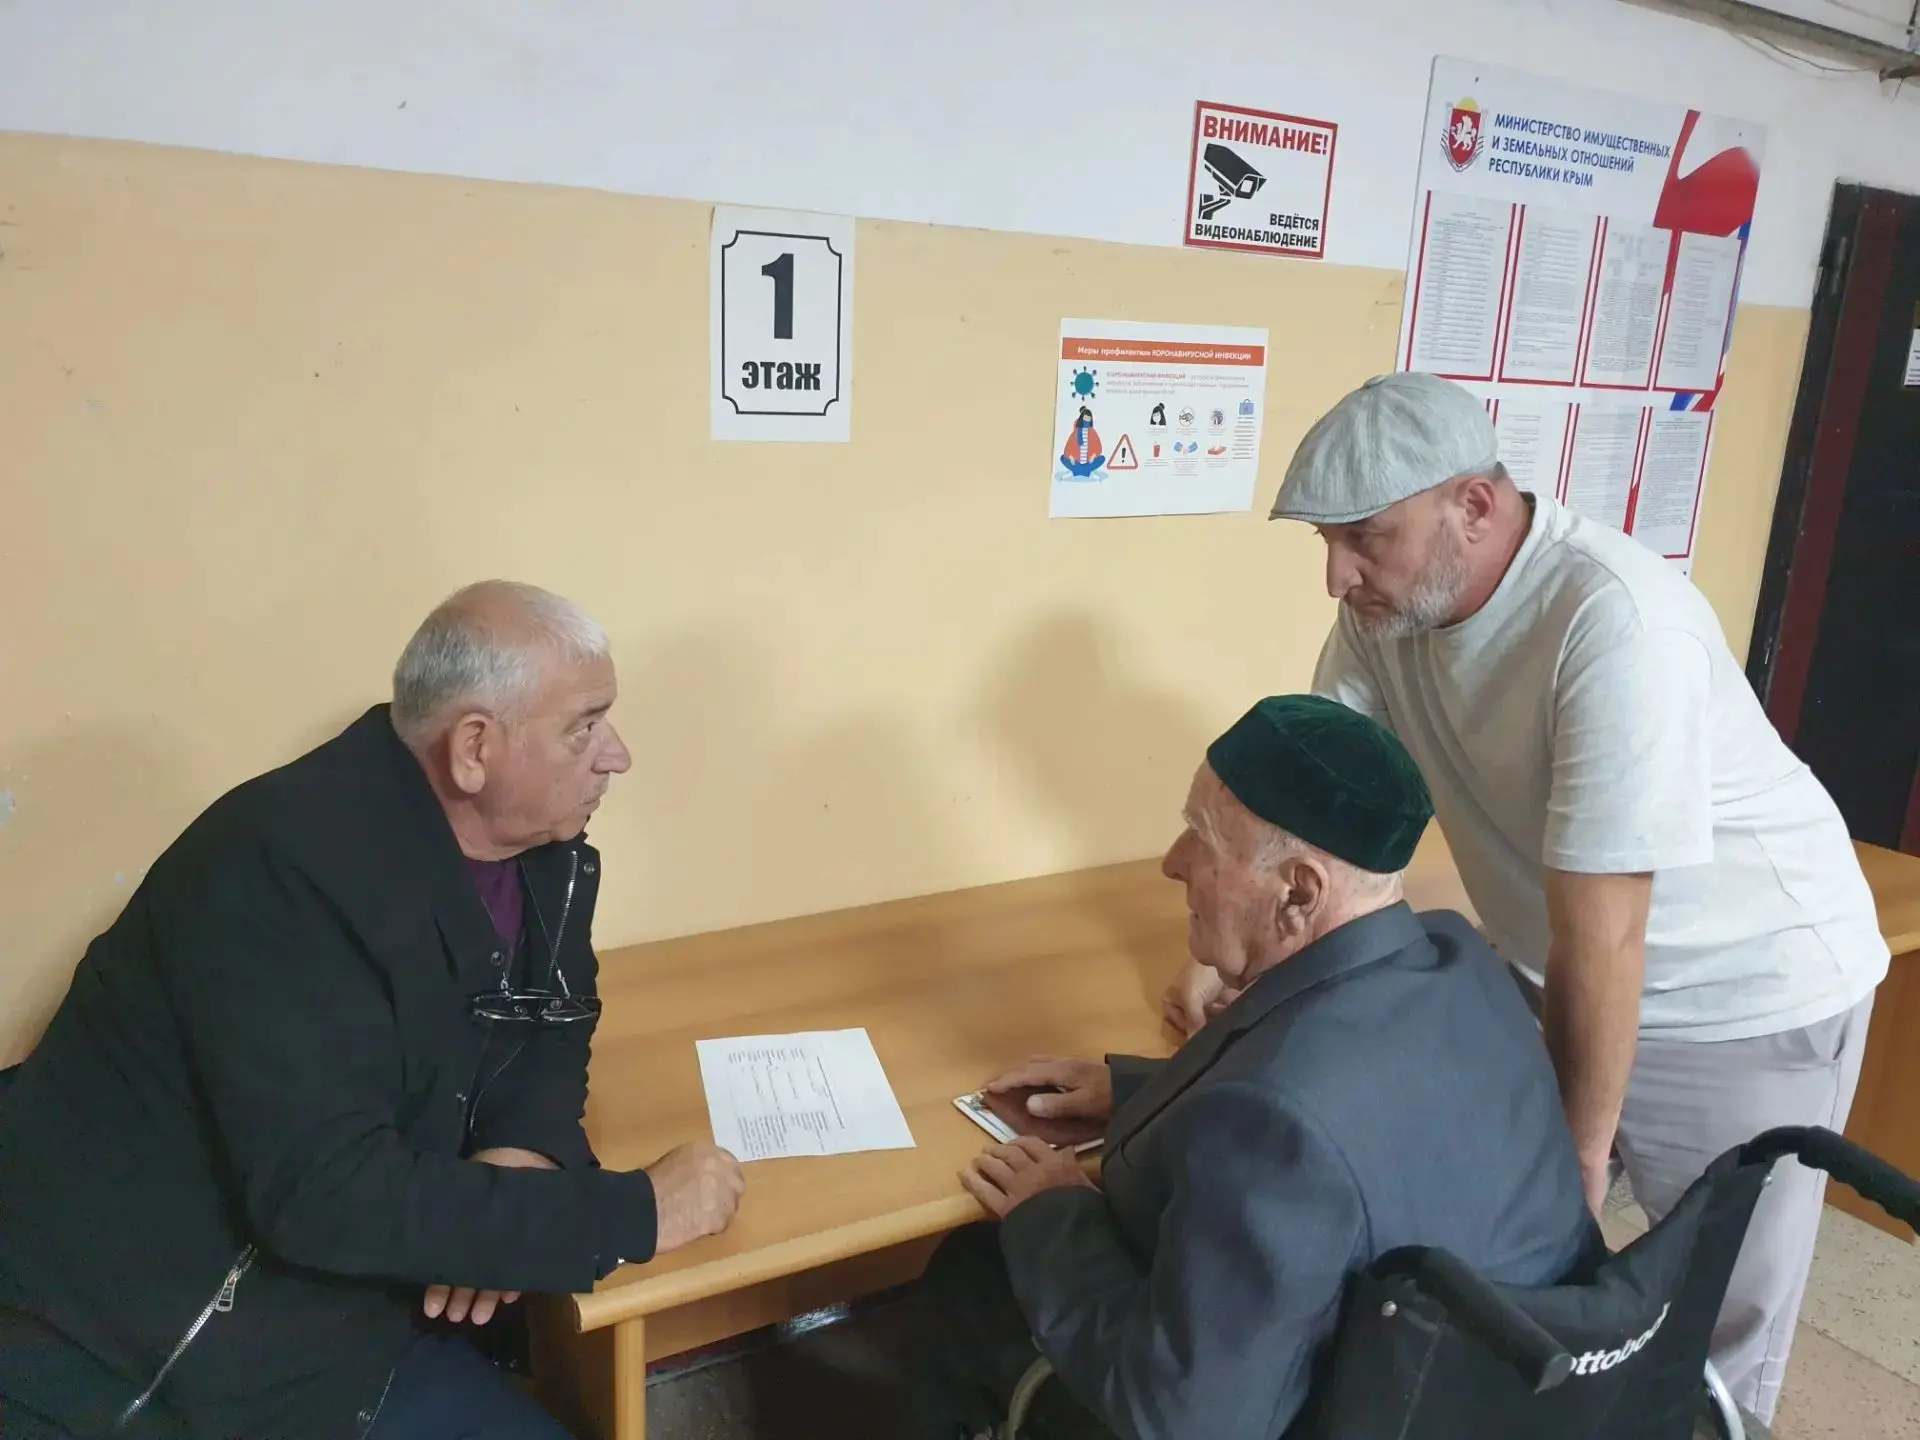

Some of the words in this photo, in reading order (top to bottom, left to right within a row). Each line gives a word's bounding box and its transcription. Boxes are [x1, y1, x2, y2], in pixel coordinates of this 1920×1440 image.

[1203, 115, 1329, 155] ВНИМАНИЕ!
[1494, 113, 1581, 142] МИНИСТЕРСТВО
[1583, 129, 1671, 158] ИМУЩЕСТВЕННЫХ
[1491, 135, 1500, 150] И
[1502, 137, 1568, 161] ЗЕМЕЛЬНЫХ
[1571, 149, 1635, 172] ОТНОШЕНИЙ
[1488, 157, 1560, 181] РЕСПУБЛИКИ
[1562, 170, 1593, 187] КРЫМ
[1195, 223, 1318, 248] ВИДЕОНАБЛЮДЕНИЕ
[1269, 213, 1320, 231] ВЕДЁТСЯ
[761, 253, 794, 340] 1
[1077, 345, 1099, 356] Меры
[1152, 349, 1214, 359] КОРОНАВИРУСНОЙ
[1214, 351, 1251, 361] ИНФЕКЦИИ
[741, 360, 821, 391] этаж
